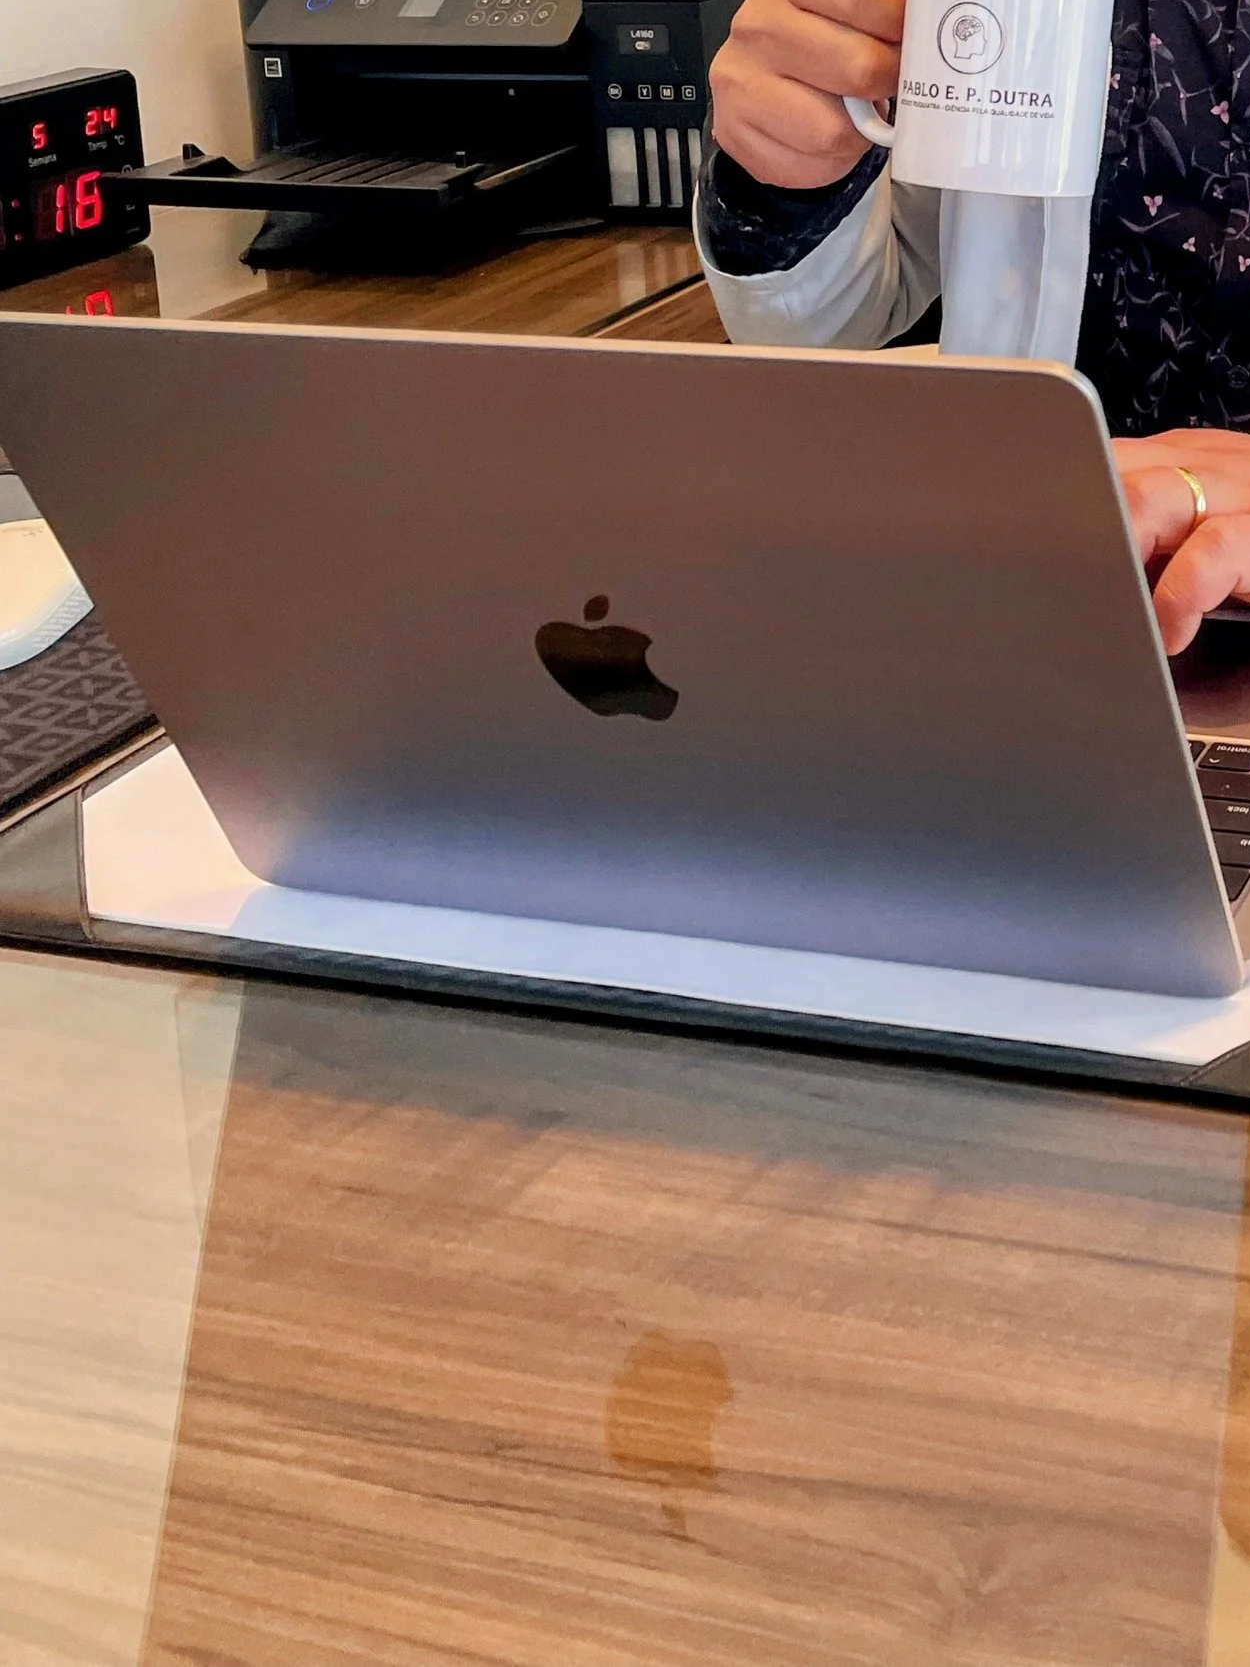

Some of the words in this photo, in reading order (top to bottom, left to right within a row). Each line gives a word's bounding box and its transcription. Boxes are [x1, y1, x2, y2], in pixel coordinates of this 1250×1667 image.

[902, 80, 939, 99] PABLO
[945, 85, 959, 100] E.
[966, 87, 981, 102] P.
[989, 89, 1053, 108] DUTRA
[32, 123, 47, 149] 5
[85, 107, 117, 135] 24
[1227, 805, 1249, 814] lock
